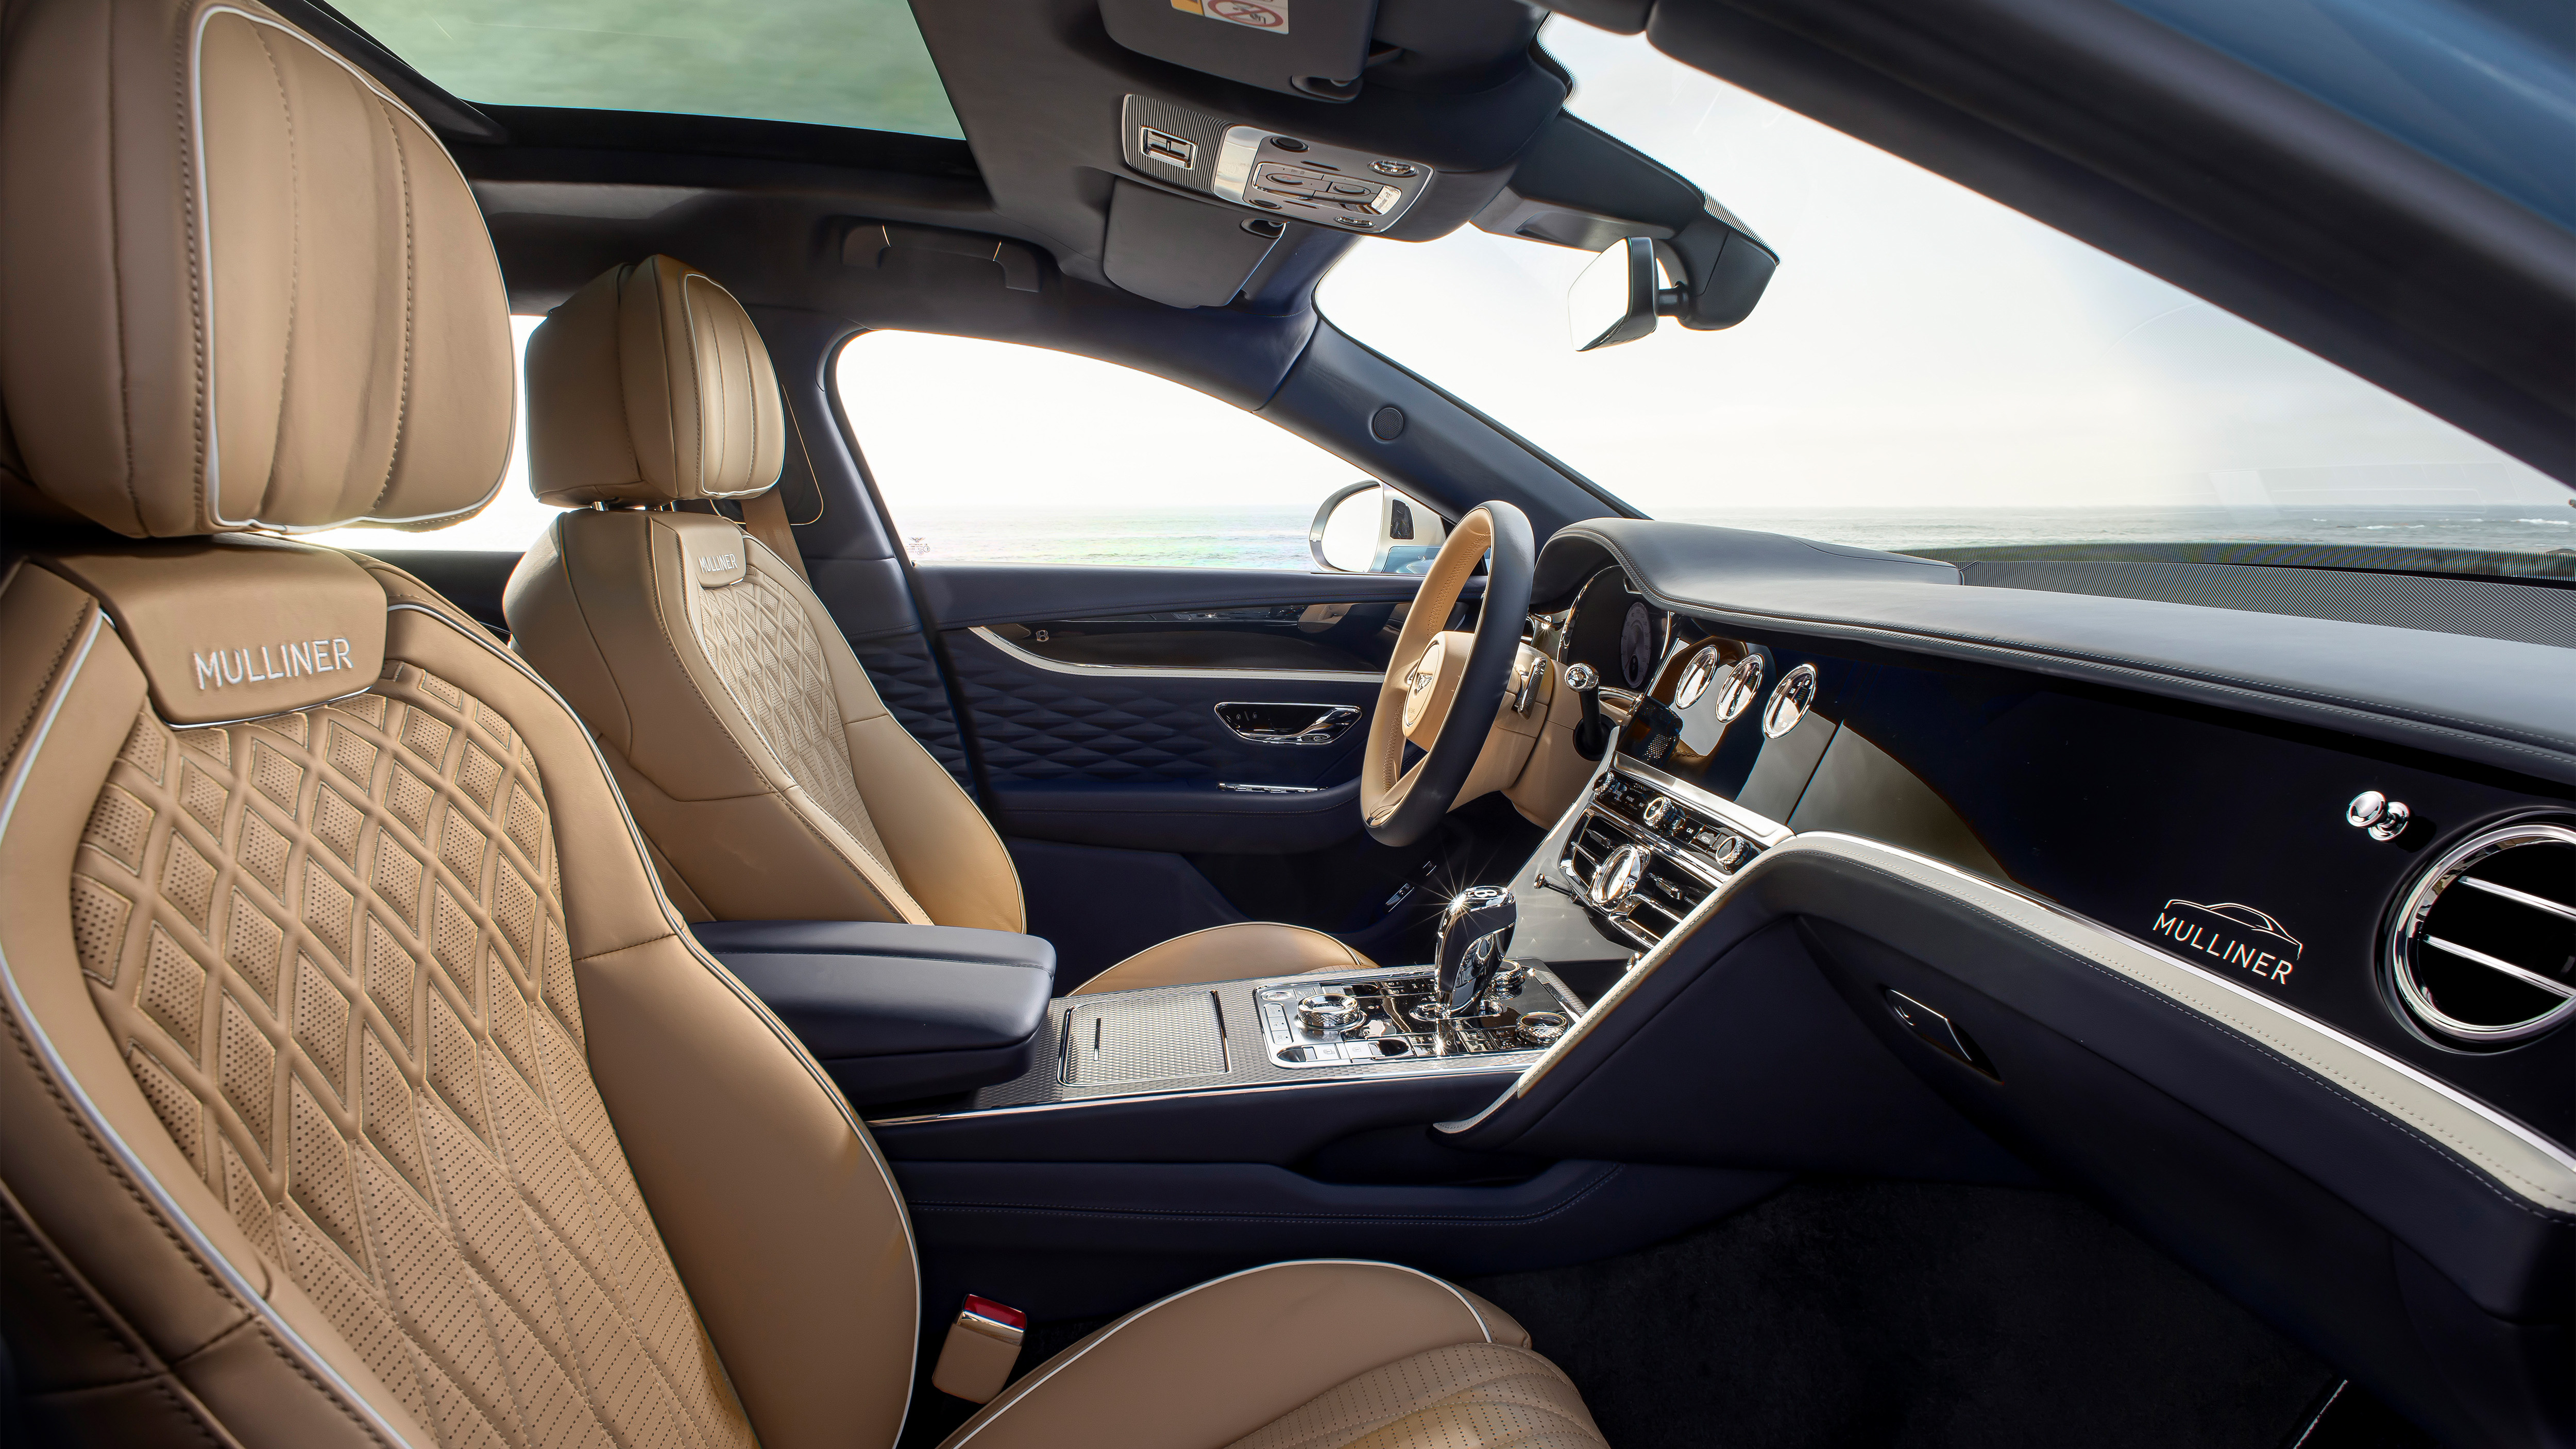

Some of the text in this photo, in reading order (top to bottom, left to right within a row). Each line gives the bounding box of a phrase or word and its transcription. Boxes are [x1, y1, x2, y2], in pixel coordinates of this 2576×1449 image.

[698, 553, 738, 574] MULLINER
[1036, 630, 1049, 642] B
[192, 636, 354, 691] MULLINER
[2152, 912, 2293, 985] MULLINER
